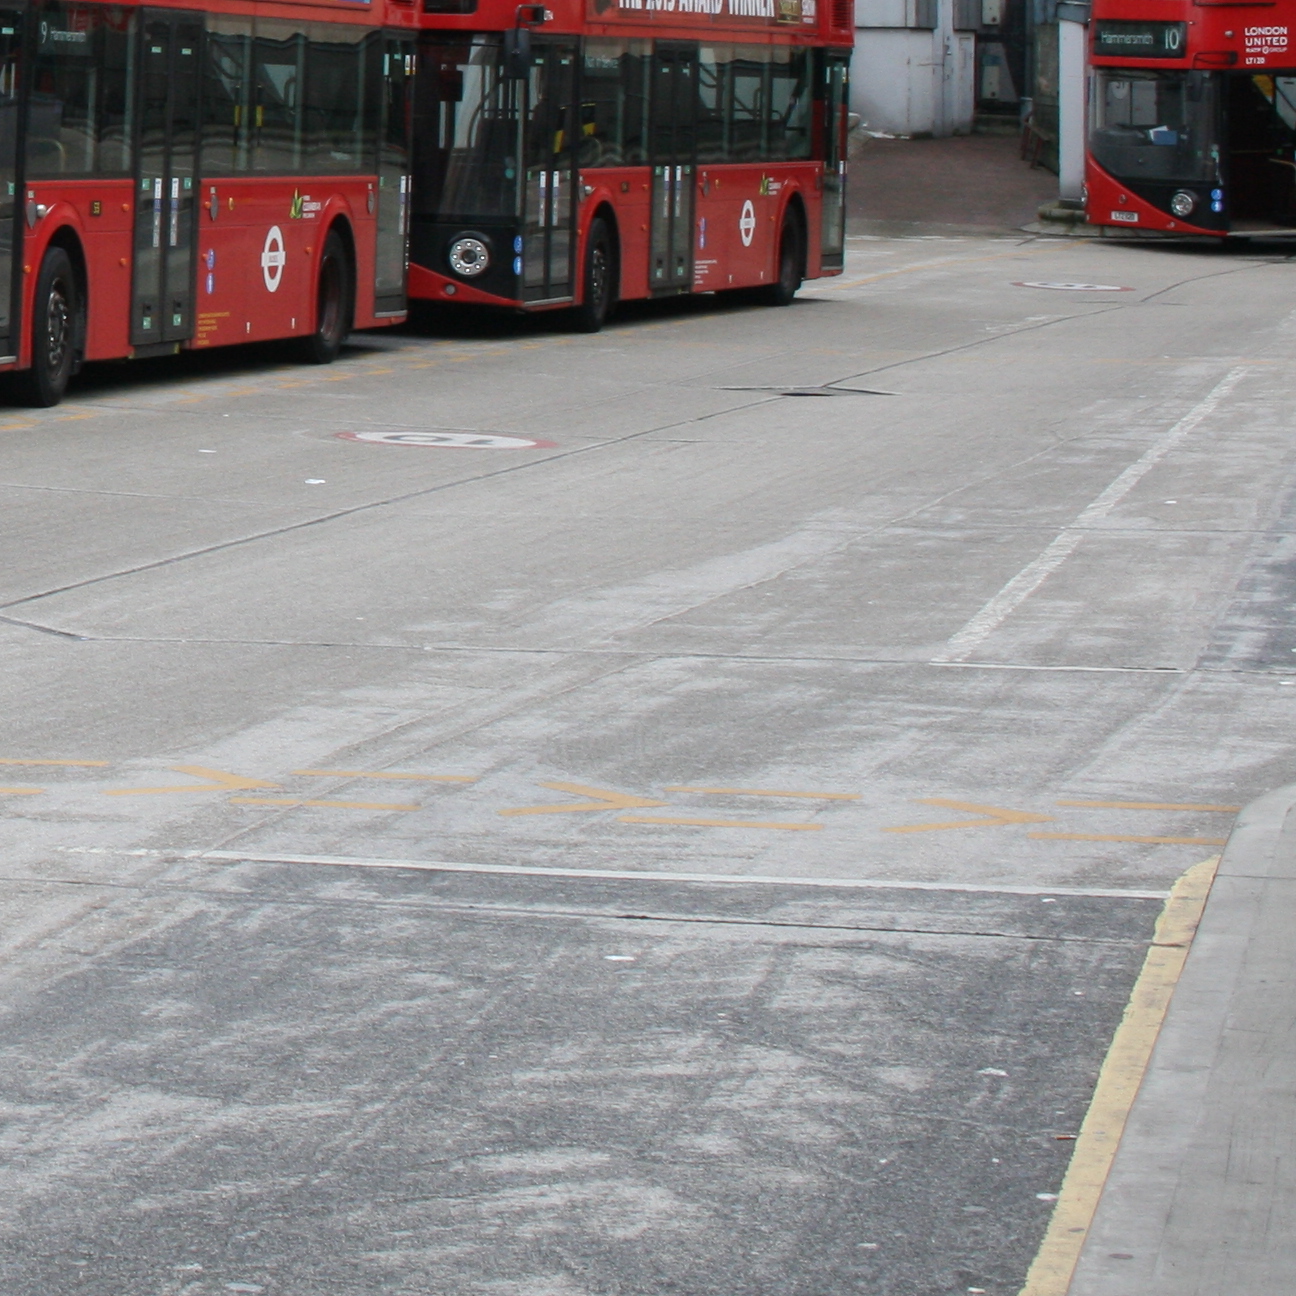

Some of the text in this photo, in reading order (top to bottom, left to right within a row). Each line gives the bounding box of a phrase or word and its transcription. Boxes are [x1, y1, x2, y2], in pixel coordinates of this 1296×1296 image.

[41, 21, 48, 44] 9
[1165, 28, 1180, 50] 10
[1244, 26, 1288, 36] LONDON
[1245, 36, 1288, 46] UNITED
